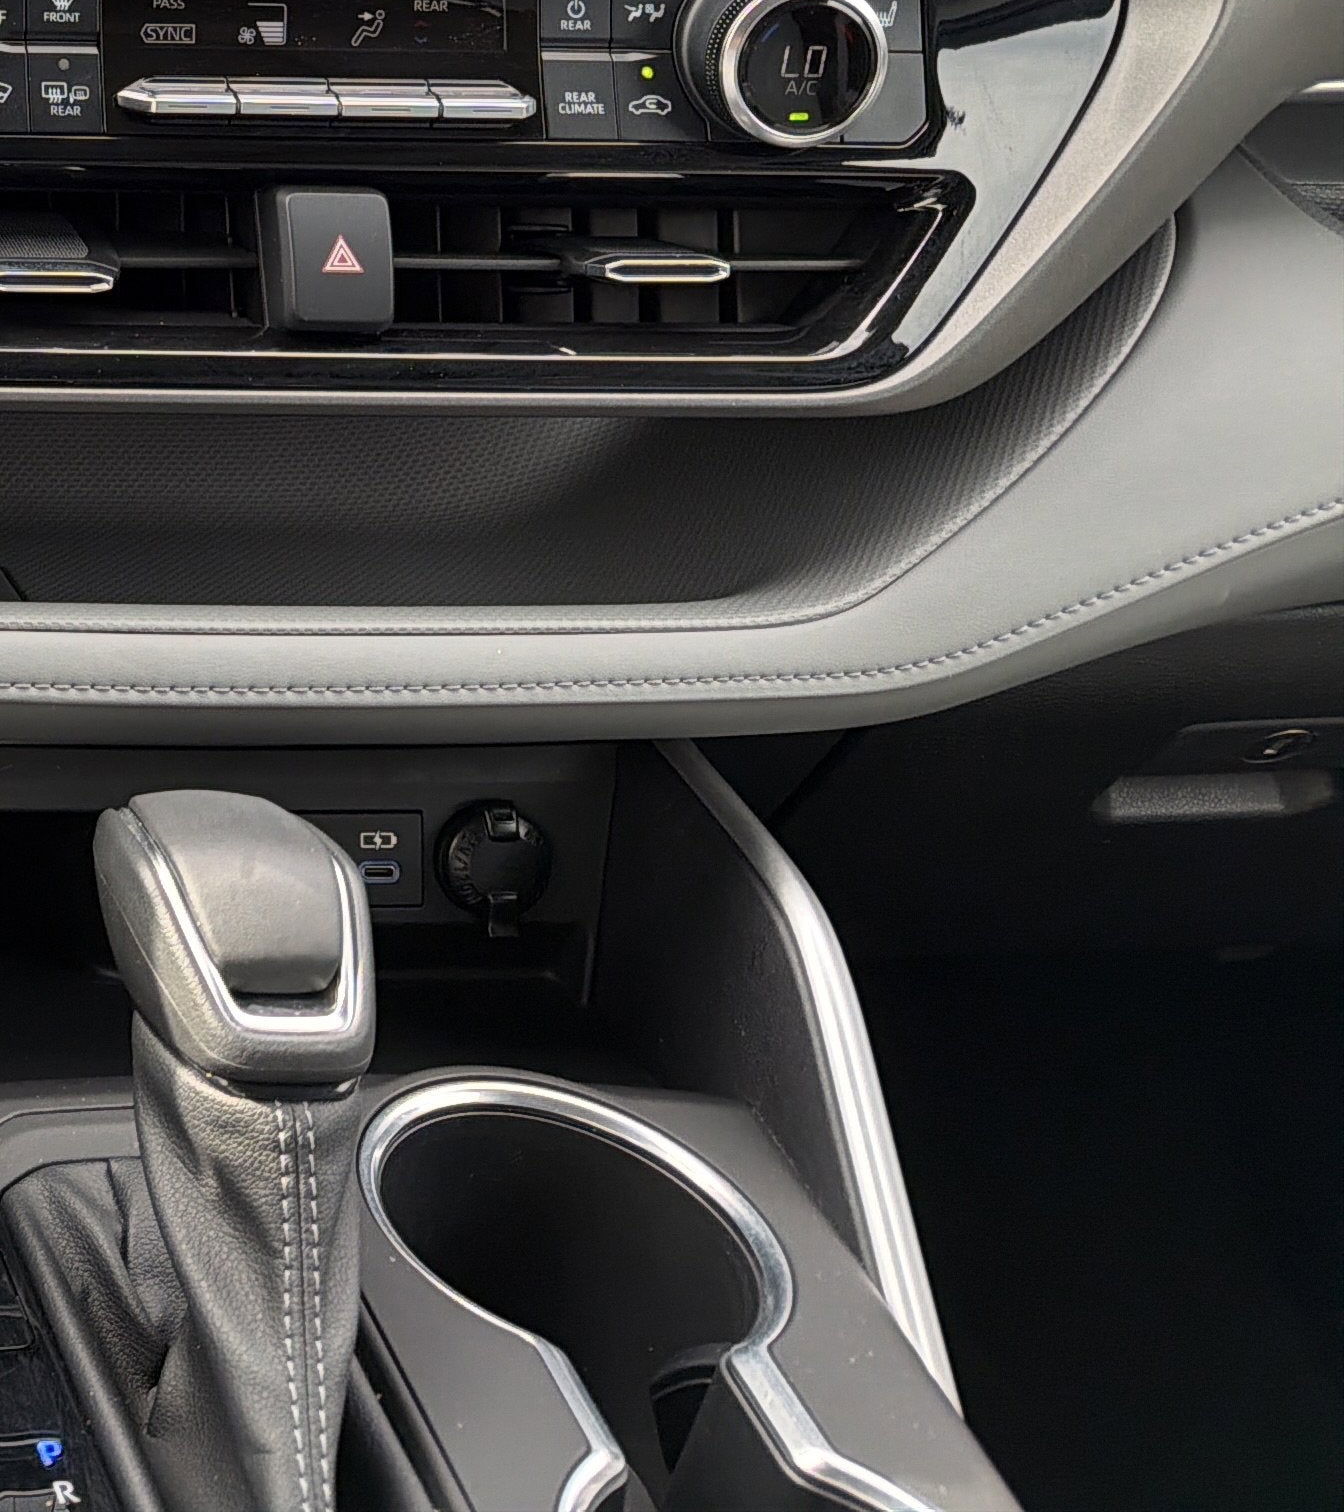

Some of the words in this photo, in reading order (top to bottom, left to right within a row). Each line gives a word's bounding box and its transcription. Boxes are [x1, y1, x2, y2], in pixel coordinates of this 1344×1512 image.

[413, 0, 449, 13] REAR
[43, 12, 80, 23] FRONT
[560, 20, 591, 31] REAR
[146, 26, 192, 41] SYNC
[780, 45, 827, 78] LO
[785, 80, 818, 96] A/C
[565, 92, 596, 104] REAR
[50, 105, 81, 116] REAR
[558, 102, 605, 115] CLIMATE
[36, 1440, 63, 1466] P
[52, 1480, 81, 1506] R
